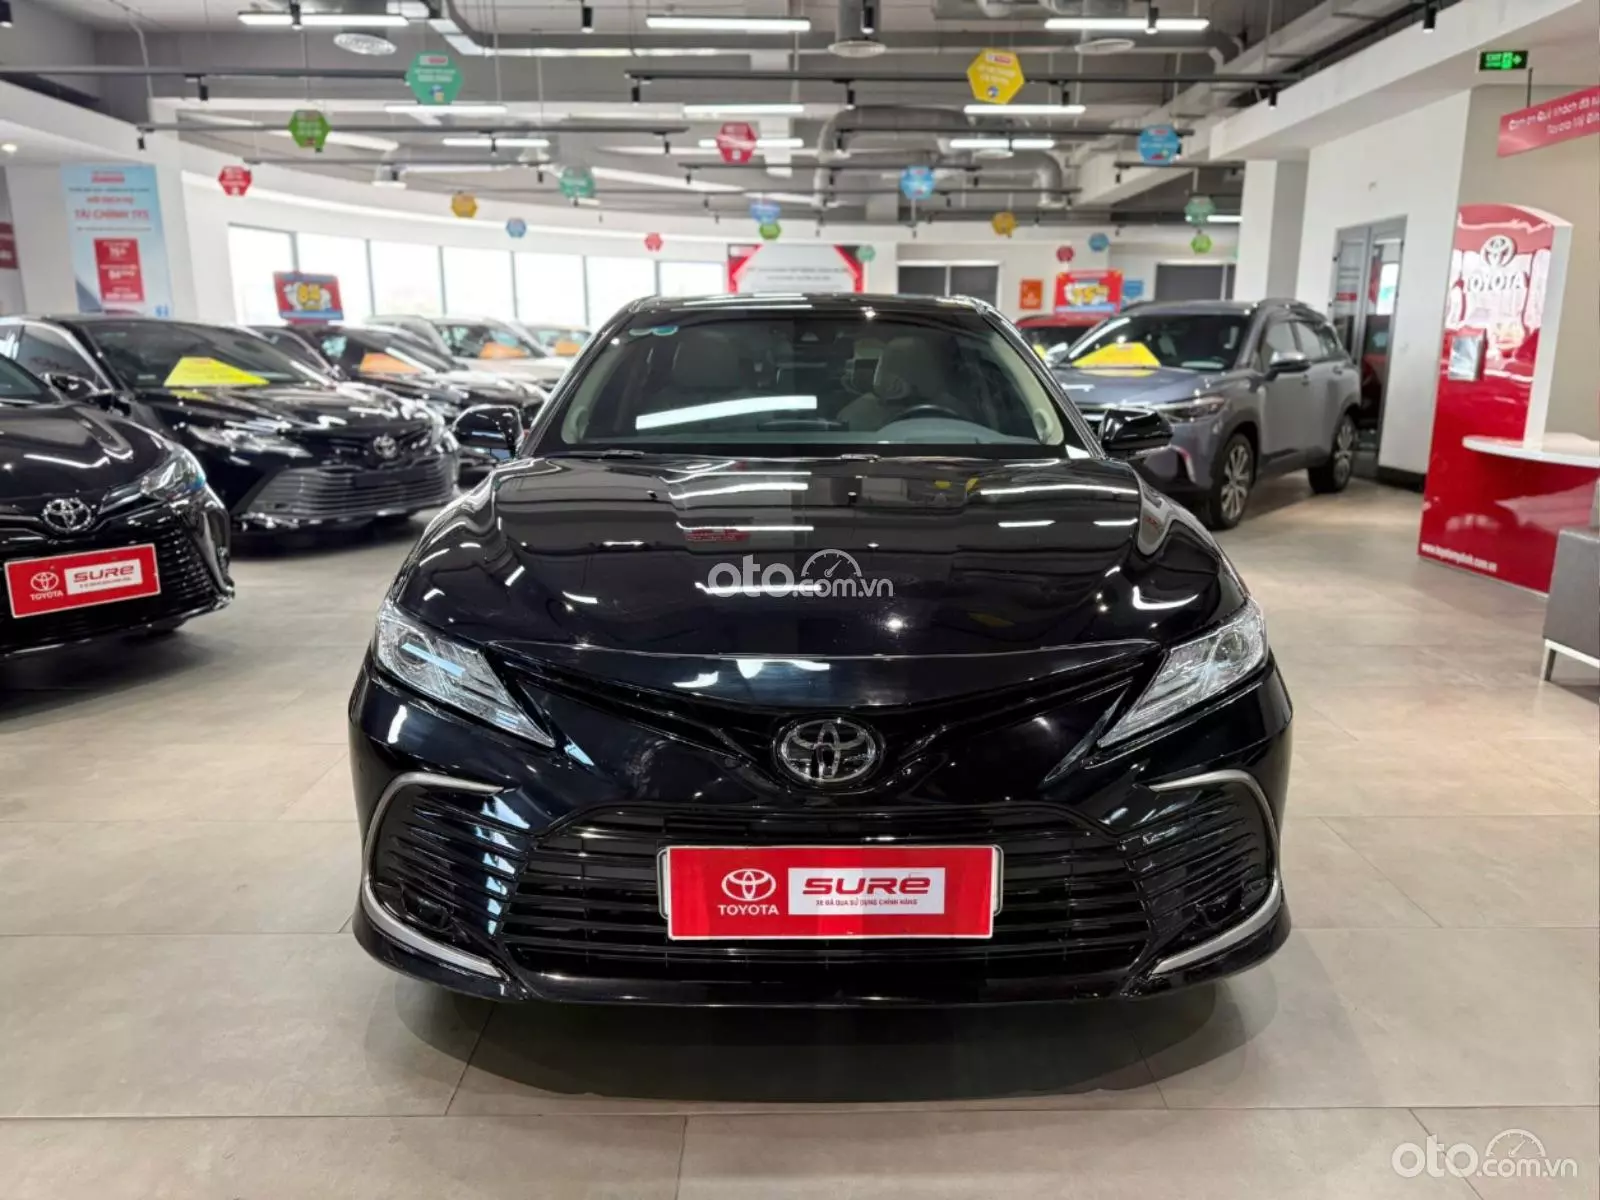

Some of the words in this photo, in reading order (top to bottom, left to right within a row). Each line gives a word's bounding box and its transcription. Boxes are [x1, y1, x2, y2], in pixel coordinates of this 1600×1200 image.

[1465, 271, 1526, 292] TOYOTA
[29, 590, 64, 601] TOYOTA
[717, 904, 780, 917] TOYOTA
